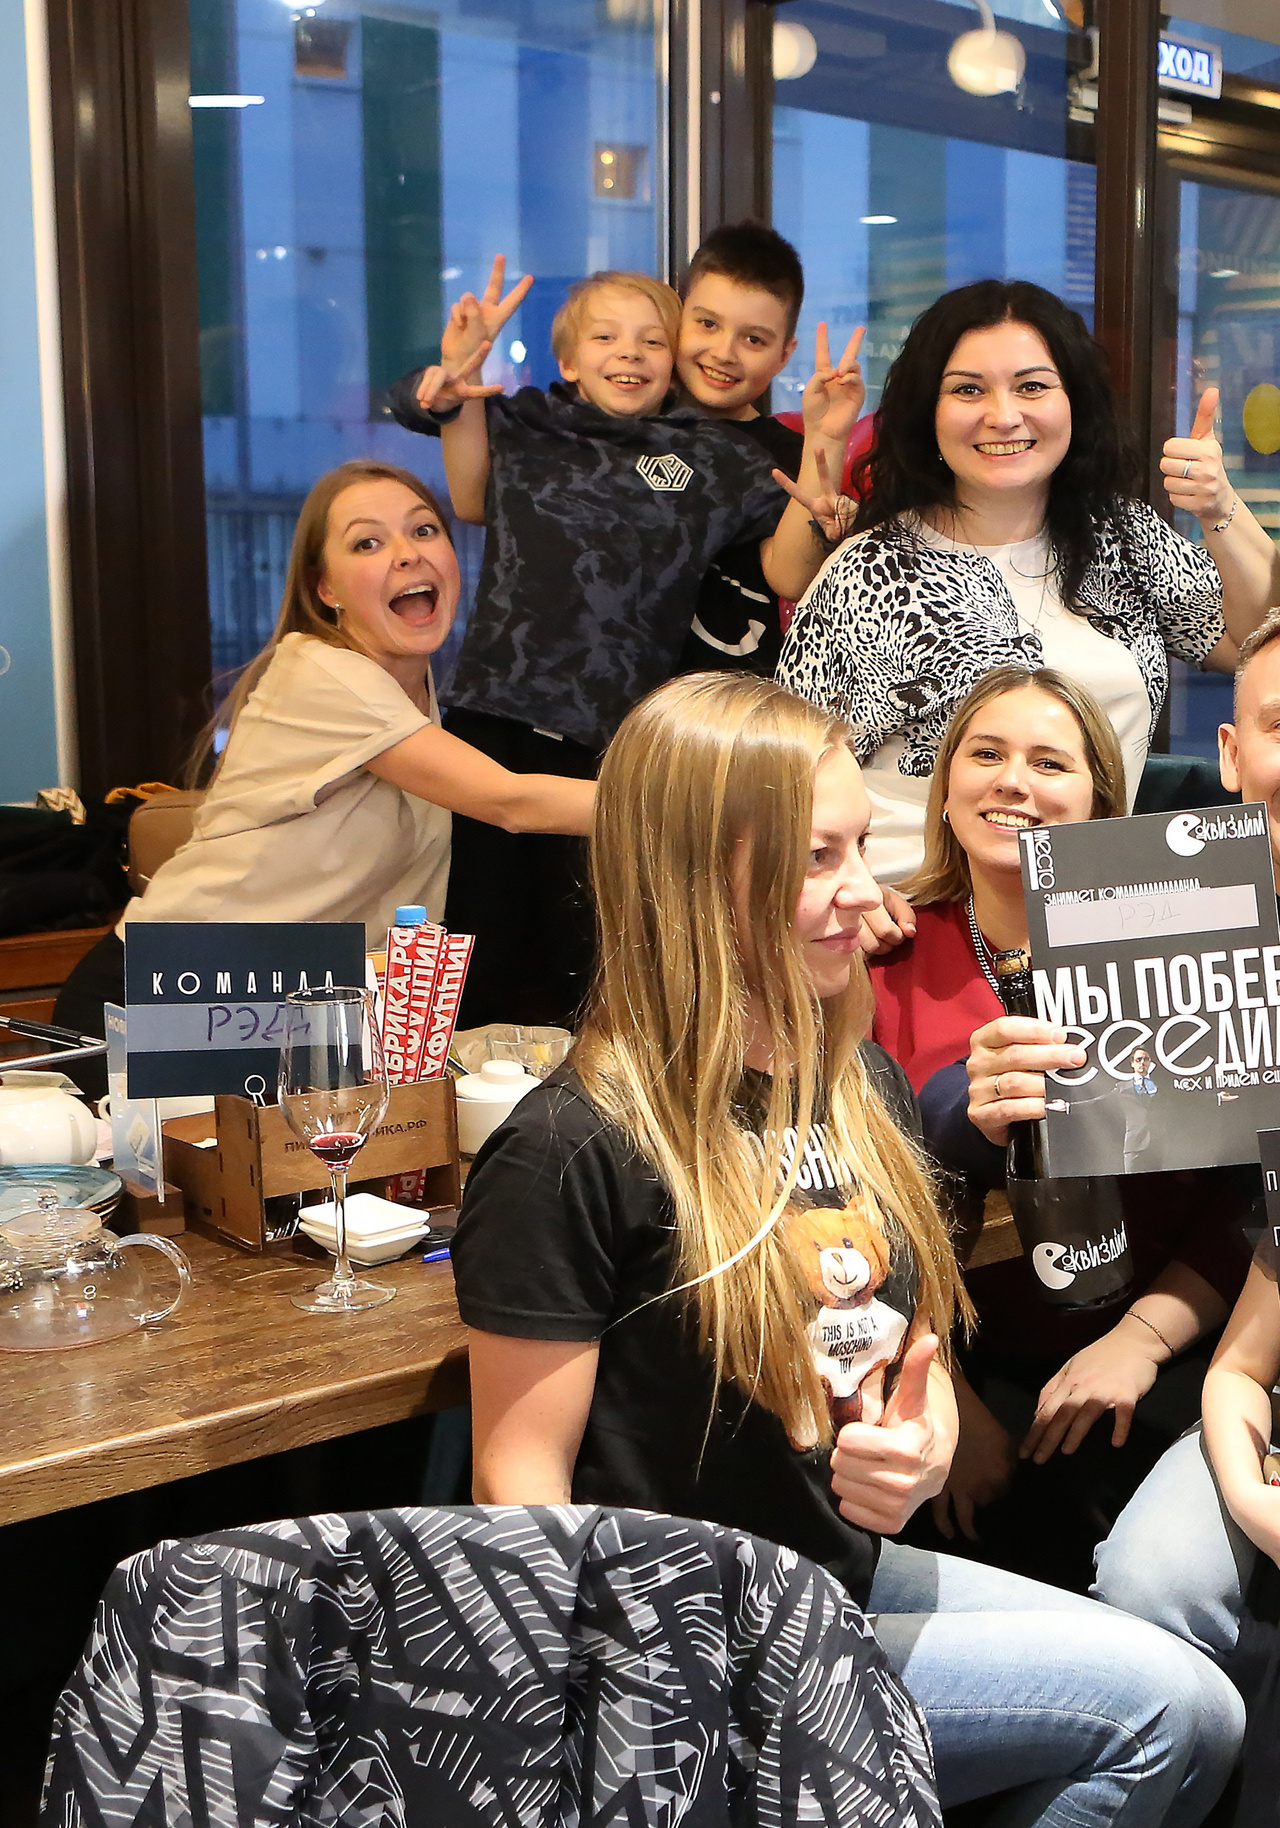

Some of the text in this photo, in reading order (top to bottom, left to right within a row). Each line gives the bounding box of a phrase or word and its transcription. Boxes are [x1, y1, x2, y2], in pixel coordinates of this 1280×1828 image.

[1032, 960, 1122, 1027] МЫ
[822, 1324, 842, 1342] THIS
[846, 1321, 855, 1339] IS
[827, 1336, 873, 1357] MOSCHINO
[839, 1356, 855, 1375] TOY
